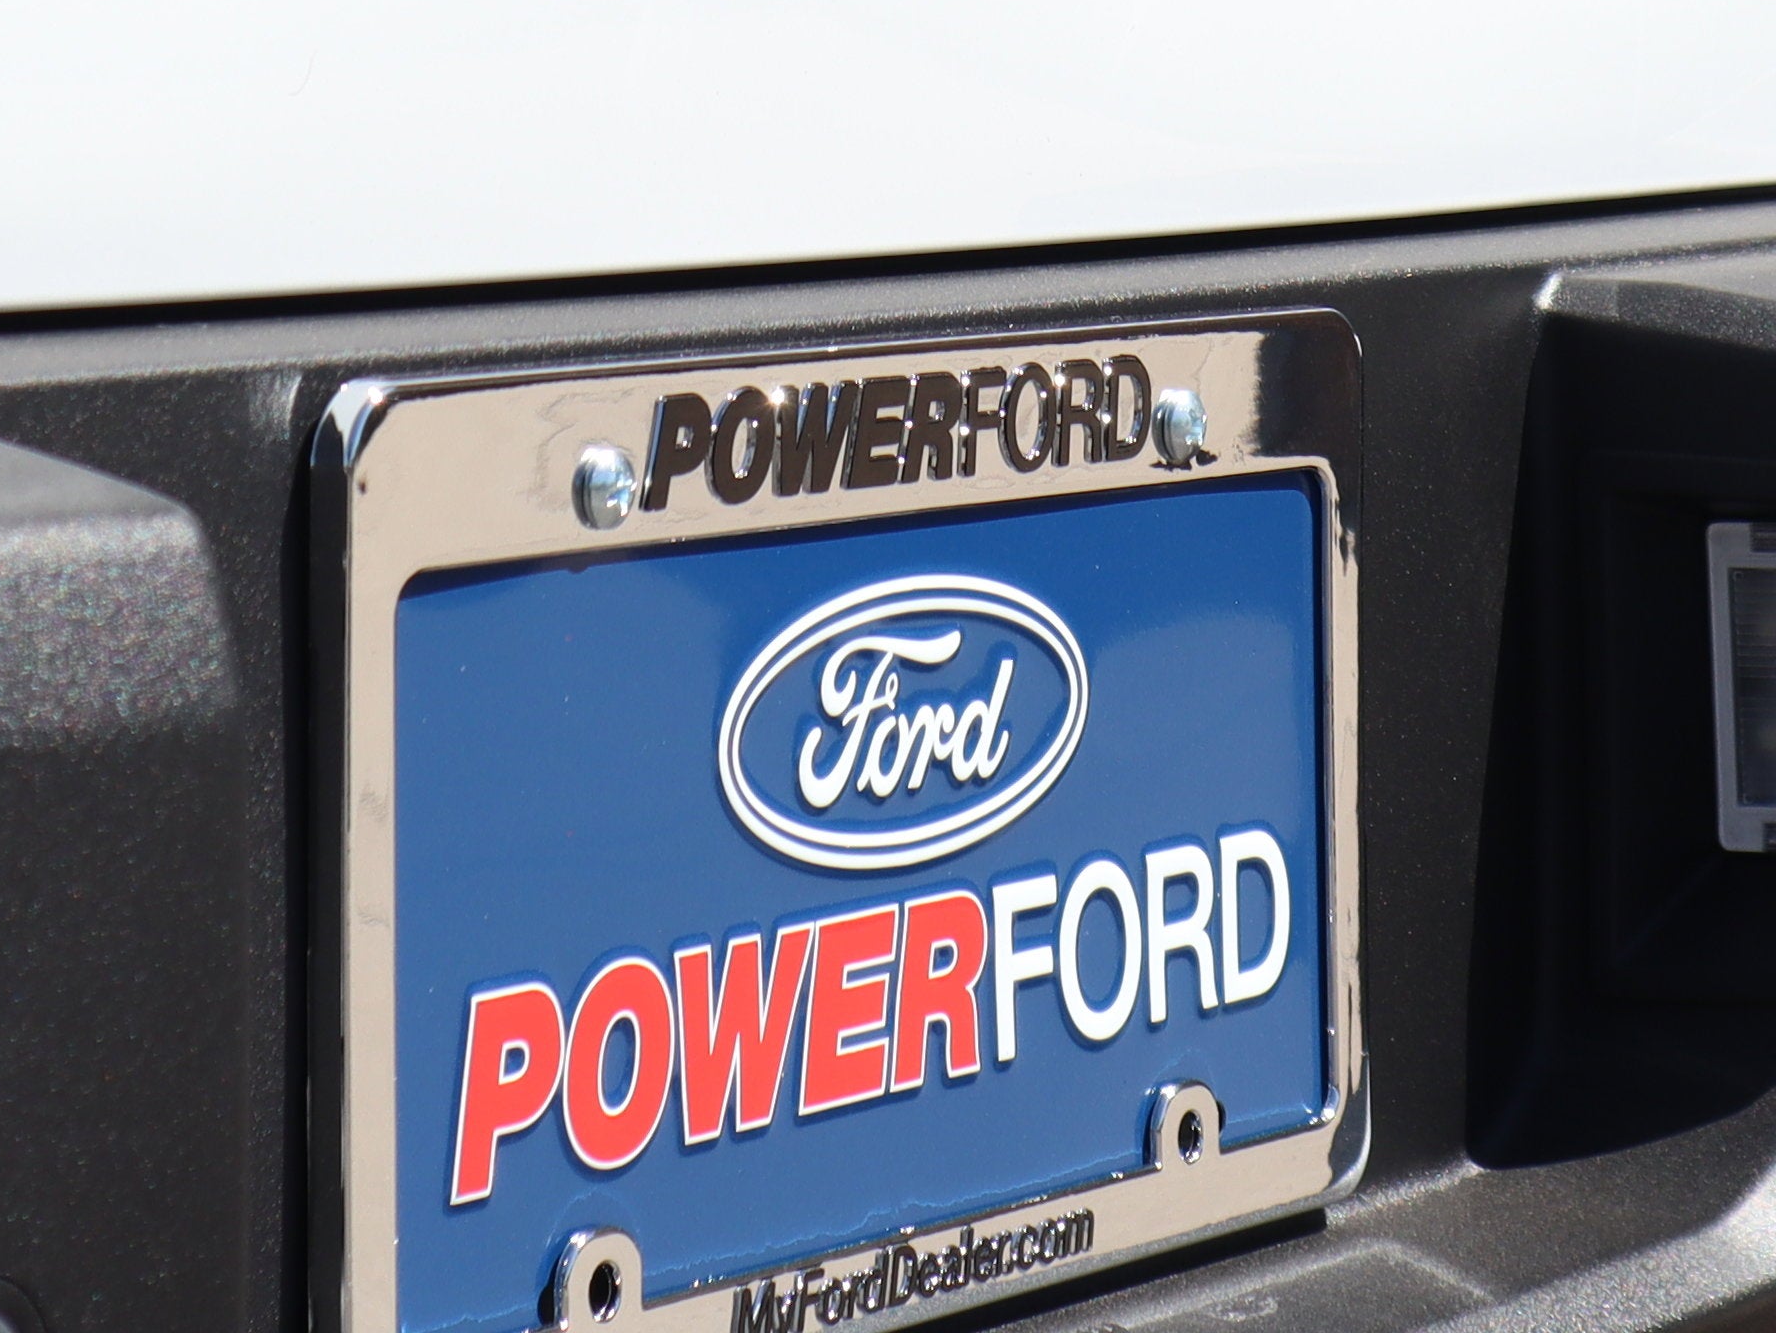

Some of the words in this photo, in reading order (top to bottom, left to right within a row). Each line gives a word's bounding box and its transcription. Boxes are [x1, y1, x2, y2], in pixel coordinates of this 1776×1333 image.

[639, 354, 1152, 512] POWERFORD
[799, 629, 1014, 807] Ford
[450, 829, 1291, 1206] POWERFORD
[730, 1207, 1096, 1333] MyFordDealer.com
